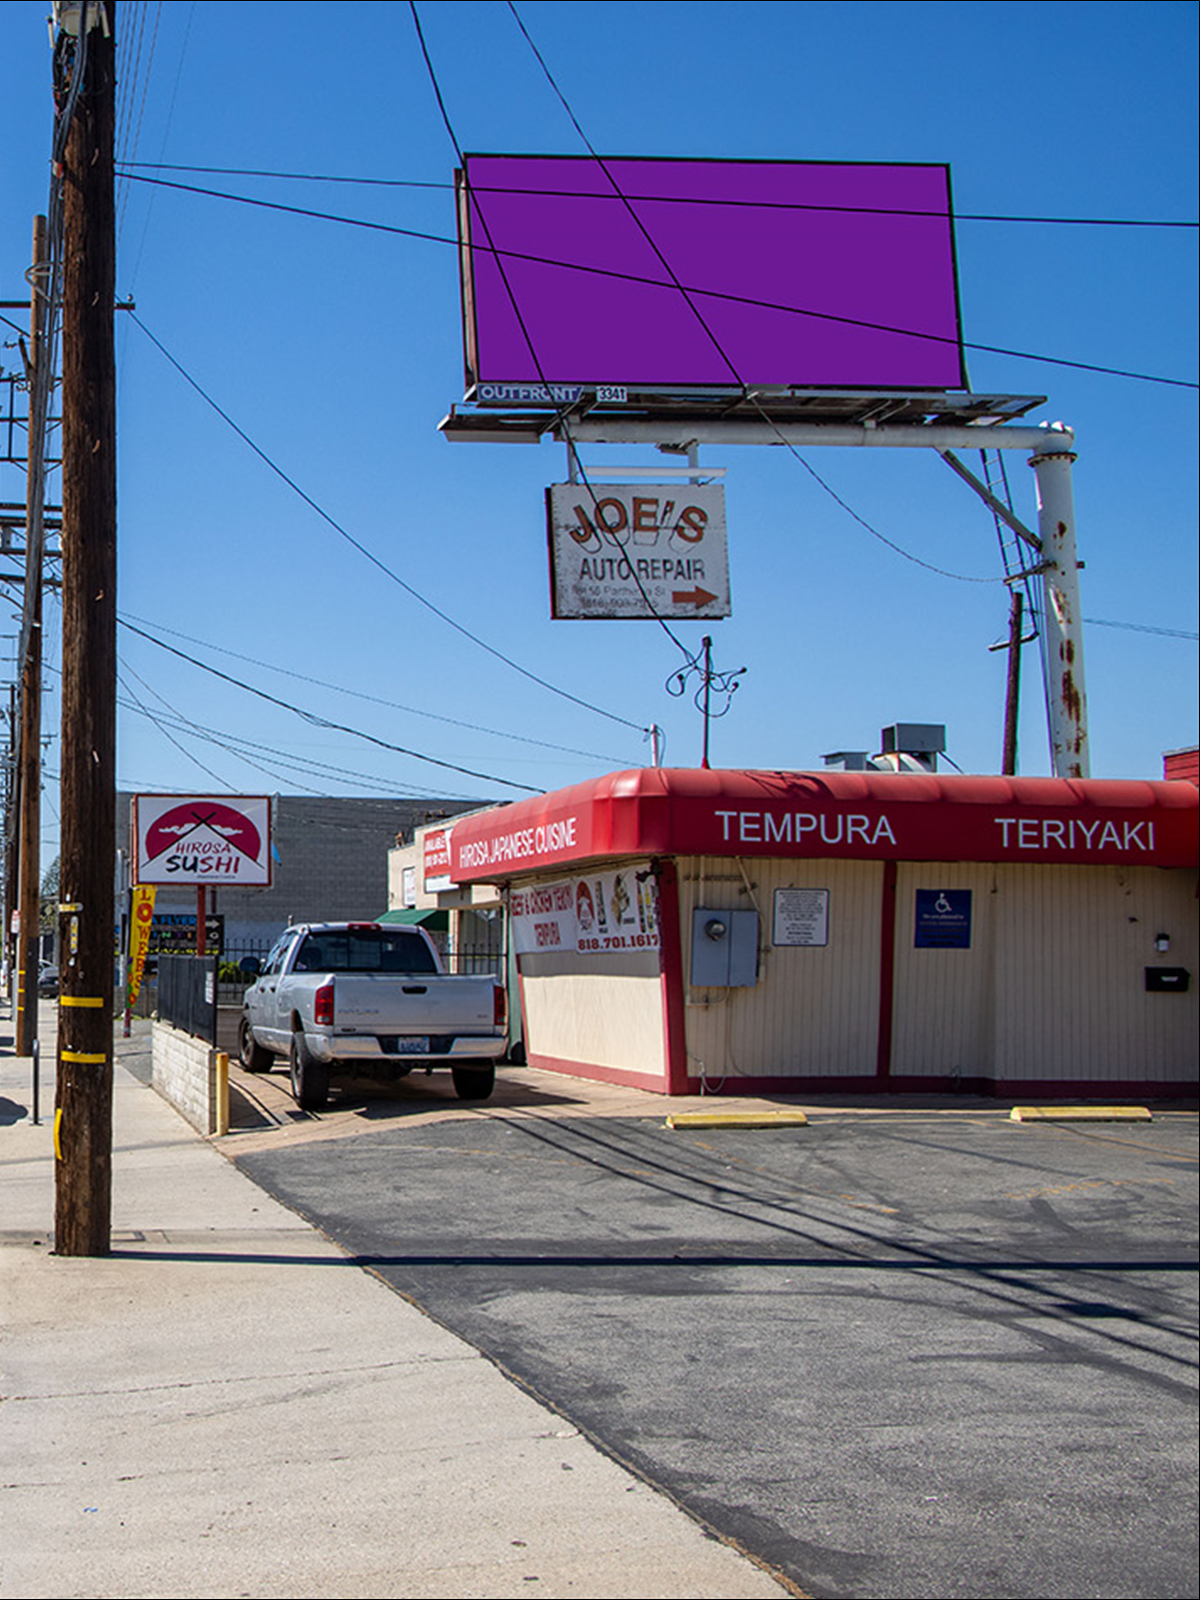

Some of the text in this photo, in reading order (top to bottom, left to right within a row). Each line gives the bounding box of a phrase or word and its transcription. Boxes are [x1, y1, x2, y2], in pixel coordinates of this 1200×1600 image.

[481, 385, 626, 400] OUTFRONT 3341
[569, 497, 708, 546] JOE'S
[580, 558, 706, 580] AUTO REPAIR
[714, 810, 1155, 851] TEMPURA TERIYAKI
[175, 841, 232, 854] HIROSA
[459, 837, 490, 868] HIROSA
[490, 828, 535, 863] JAPANESE
[535, 818, 577, 854] CUISINE
[165, 855, 240, 874] SUSHI
[160, 915, 198, 926] FLYER
[134, 889, 154, 989] LOWERS
[578, 934, 659, 951] 818.701.1617
